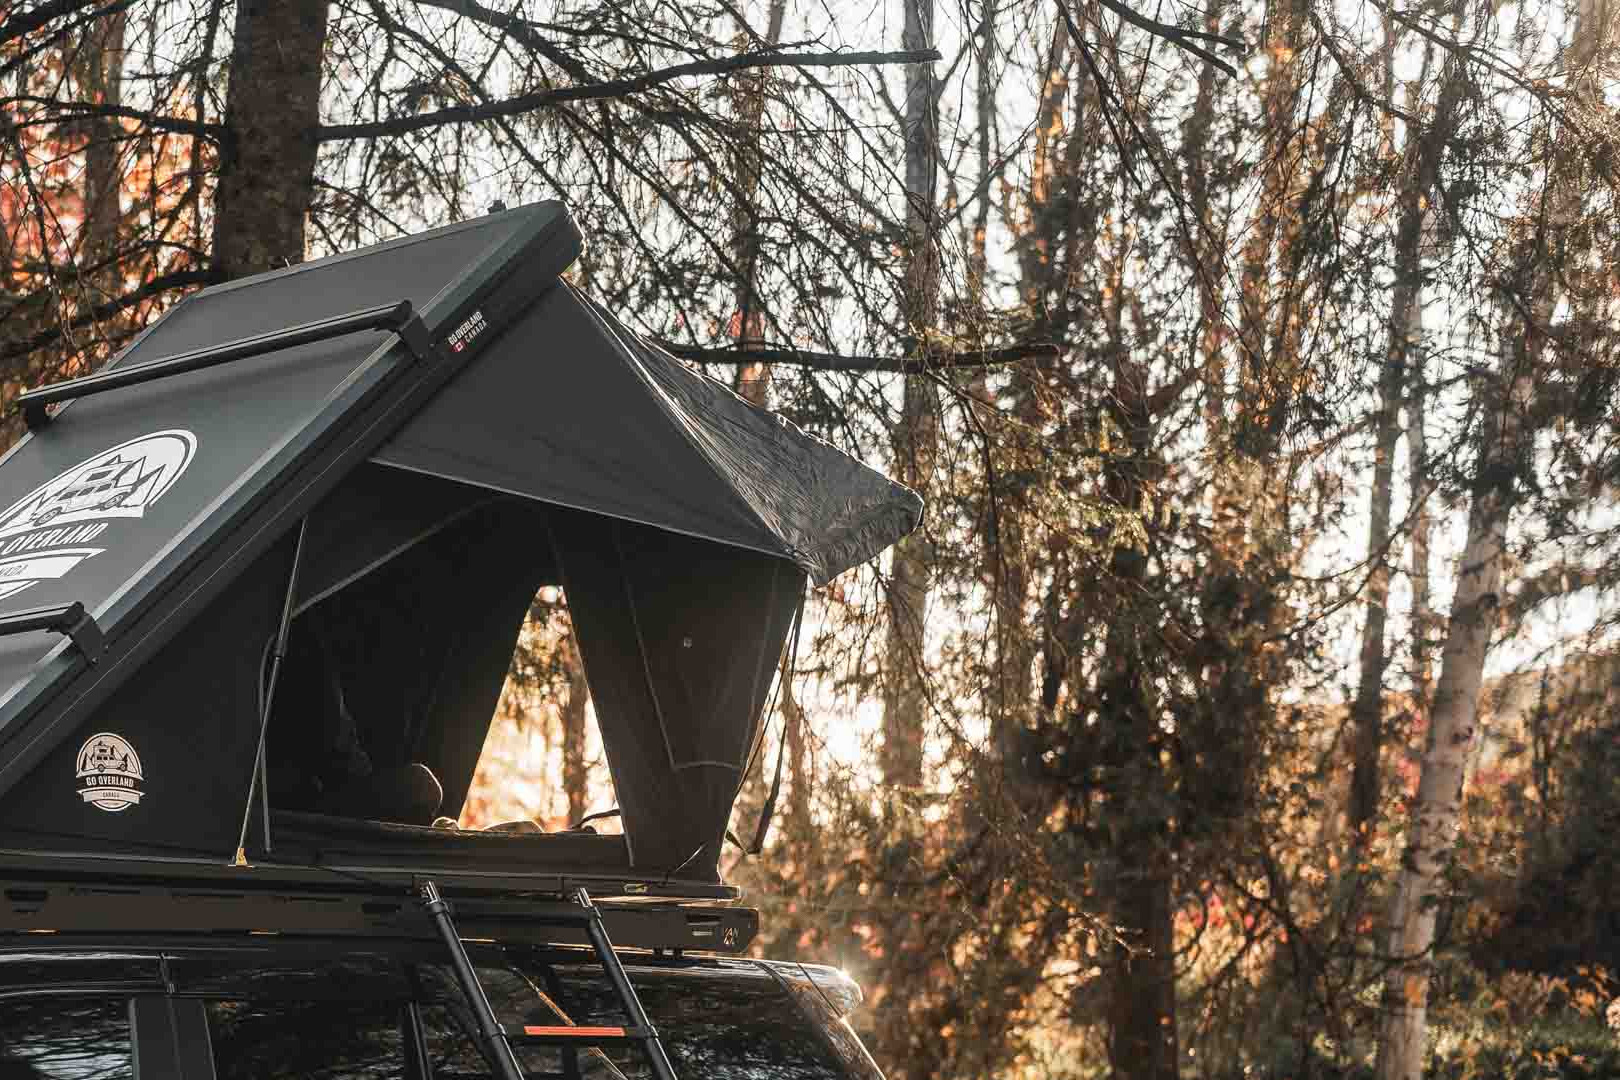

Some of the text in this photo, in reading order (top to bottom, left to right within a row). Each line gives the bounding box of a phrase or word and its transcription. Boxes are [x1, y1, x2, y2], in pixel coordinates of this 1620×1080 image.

[448, 311, 483, 345] GO OVERLAND
[464, 319, 487, 343] CANADA
[0, 522, 109, 556] OVERLAND
[86, 775, 134, 788] GO OVERLAND
